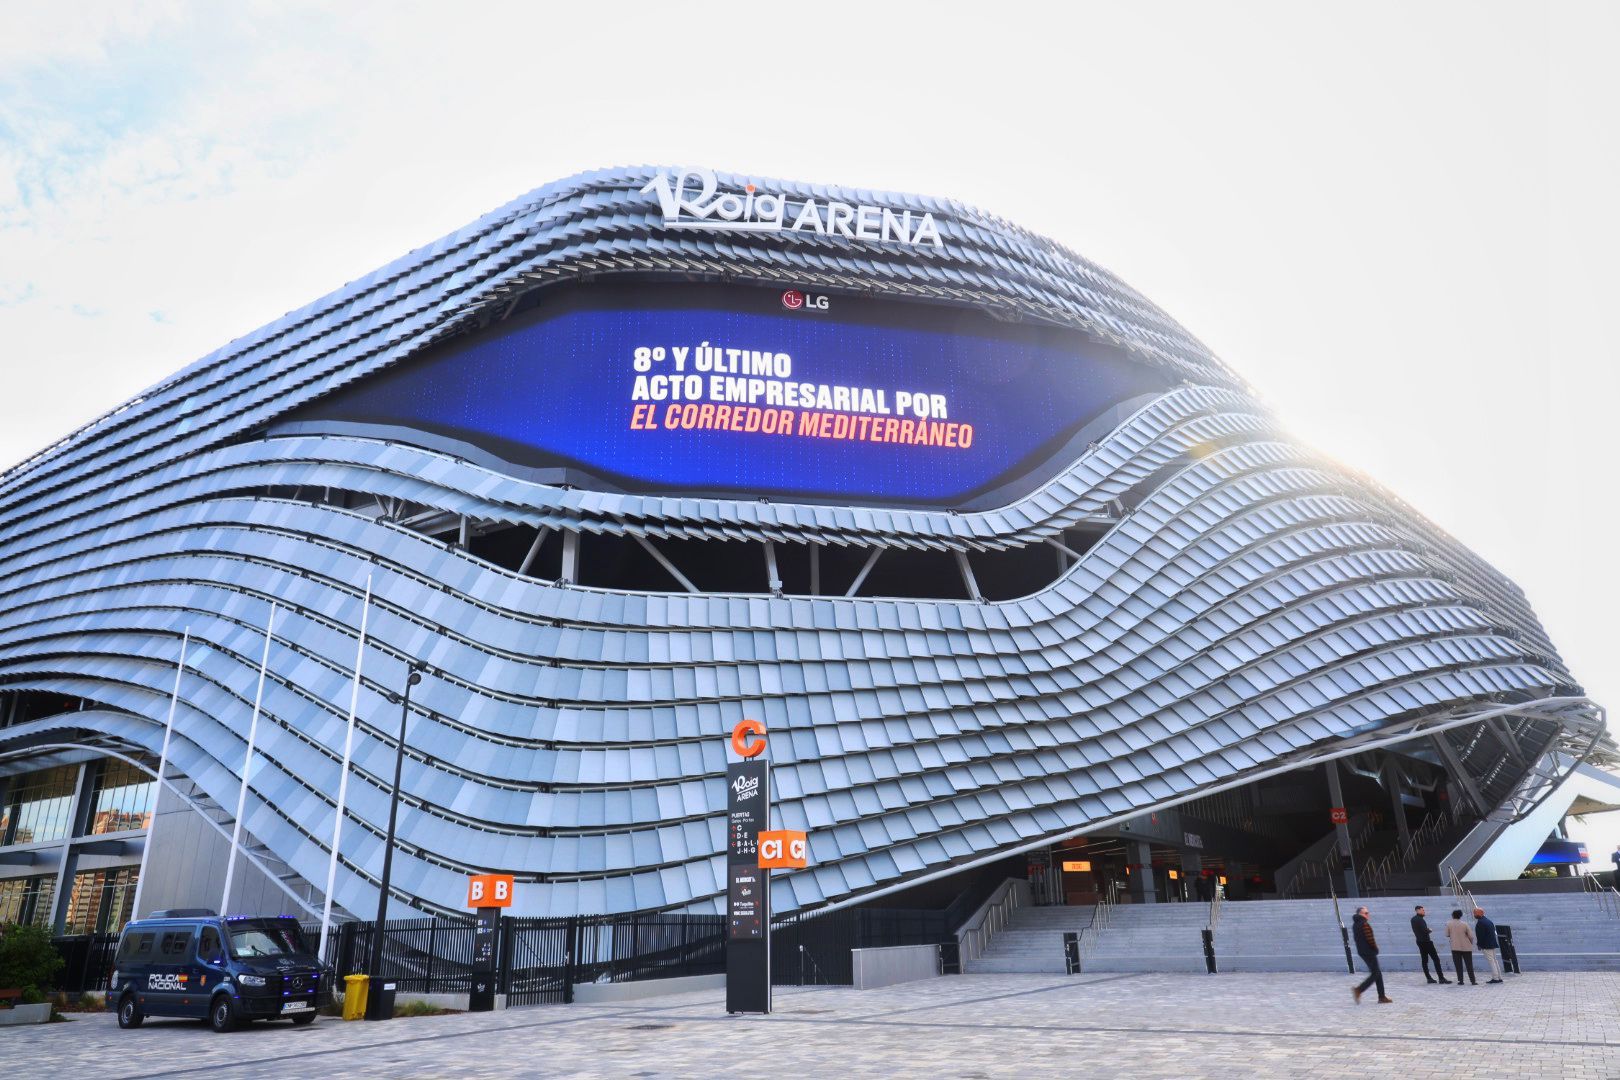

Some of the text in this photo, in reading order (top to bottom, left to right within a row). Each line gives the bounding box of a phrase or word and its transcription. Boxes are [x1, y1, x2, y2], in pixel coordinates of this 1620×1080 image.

[639, 168, 944, 250] Roig ARENA
[805, 294, 830, 311] LG
[672, 347, 690, 372] Y
[695, 341, 792, 379] ÚLTIMO
[631, 375, 948, 419] ACTO EMPRESARIAL POR
[630, 403, 974, 449] EL CORREDOR MEDITERRÁNEO
[731, 719, 767, 757] C
[731, 775, 759, 794] Roig
[736, 789, 759, 802] ARENA
[761, 839, 783, 860] C1
[471, 881, 484, 901] B
[494, 880, 508, 900] B
[148, 982, 187, 990] NACIONAL
[149, 973, 179, 982] POLICIA
